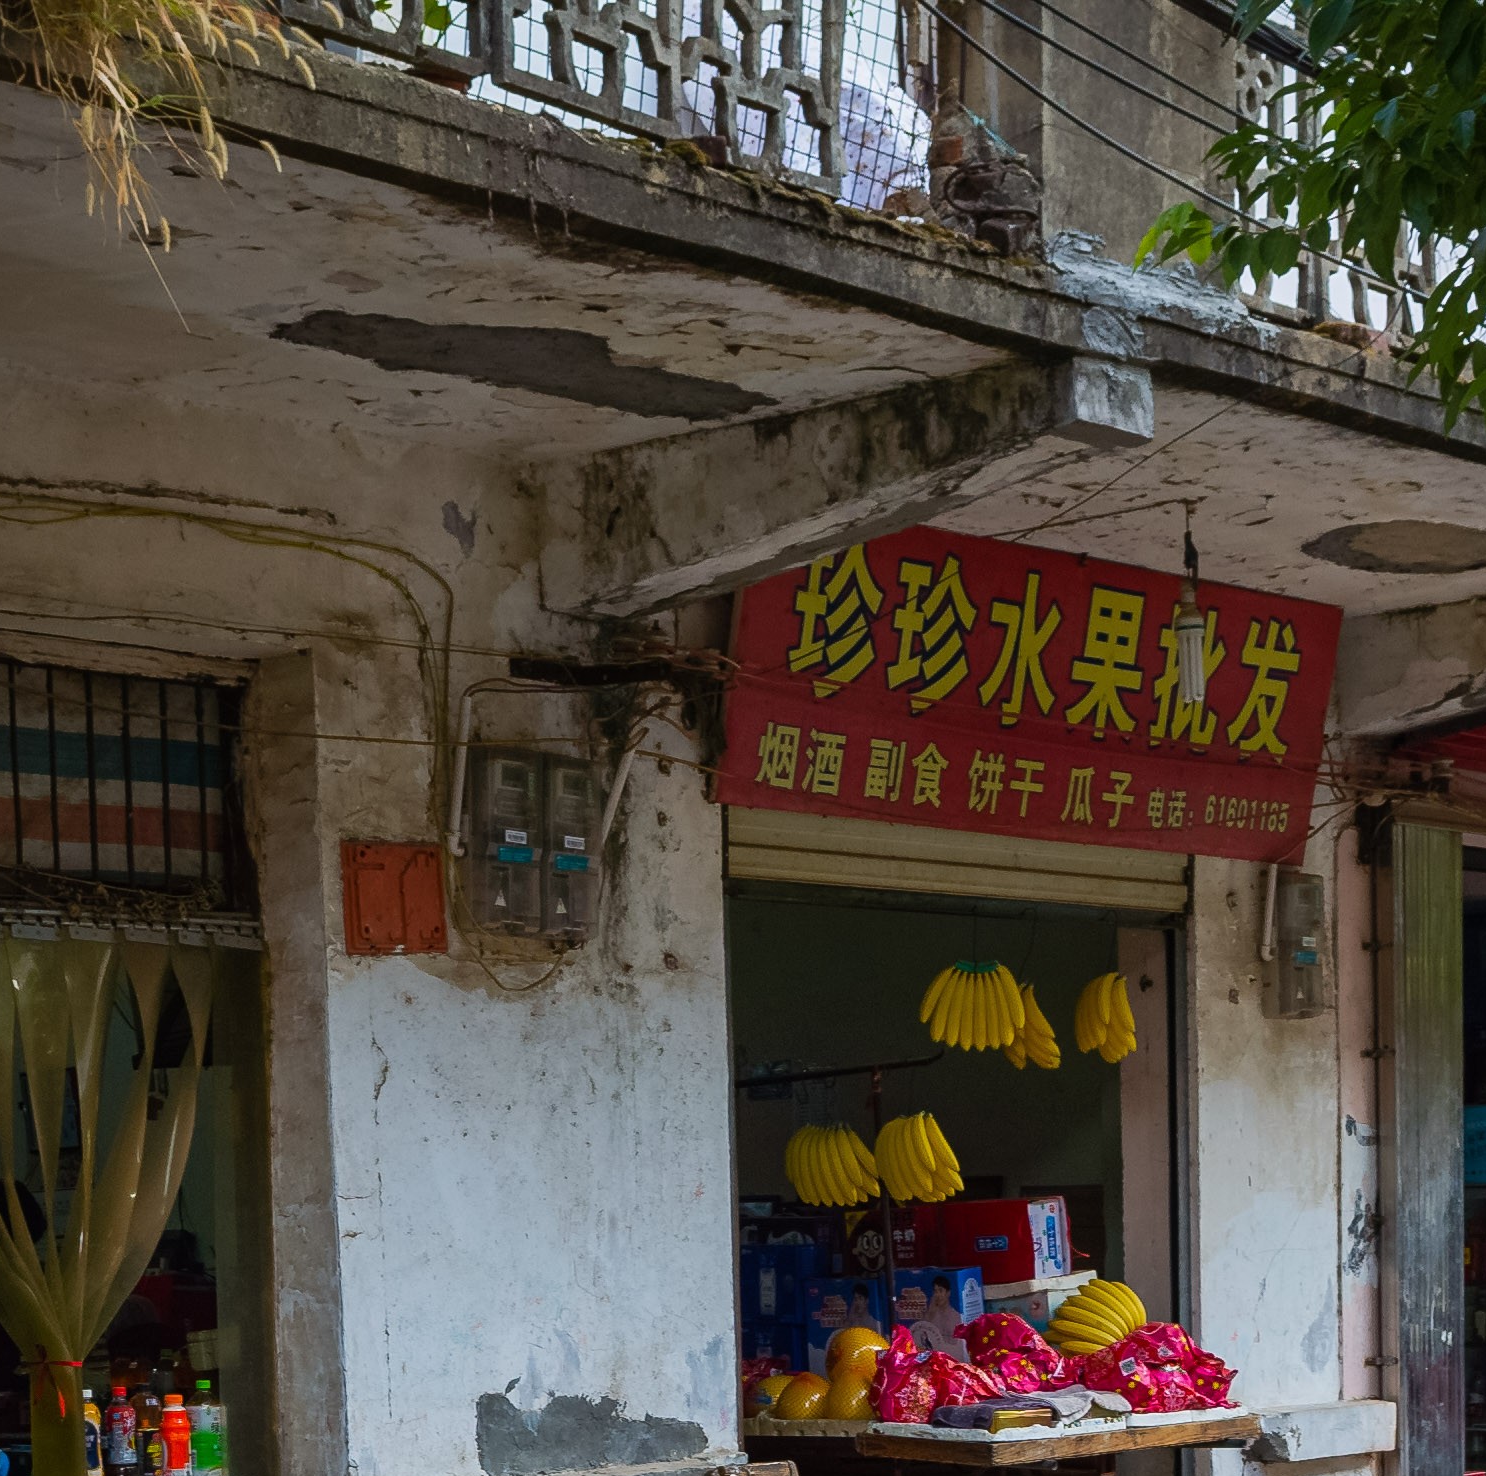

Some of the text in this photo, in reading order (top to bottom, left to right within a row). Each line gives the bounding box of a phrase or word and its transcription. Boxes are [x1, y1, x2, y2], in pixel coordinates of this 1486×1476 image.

[789, 544, 1300, 762] 珍珍水果批发
[755, 722, 847, 797] 烟酒
[864, 738, 949, 807] 副食
[968, 749, 1045, 818] 饼干
[1060, 767, 1135, 828] 瓜子
